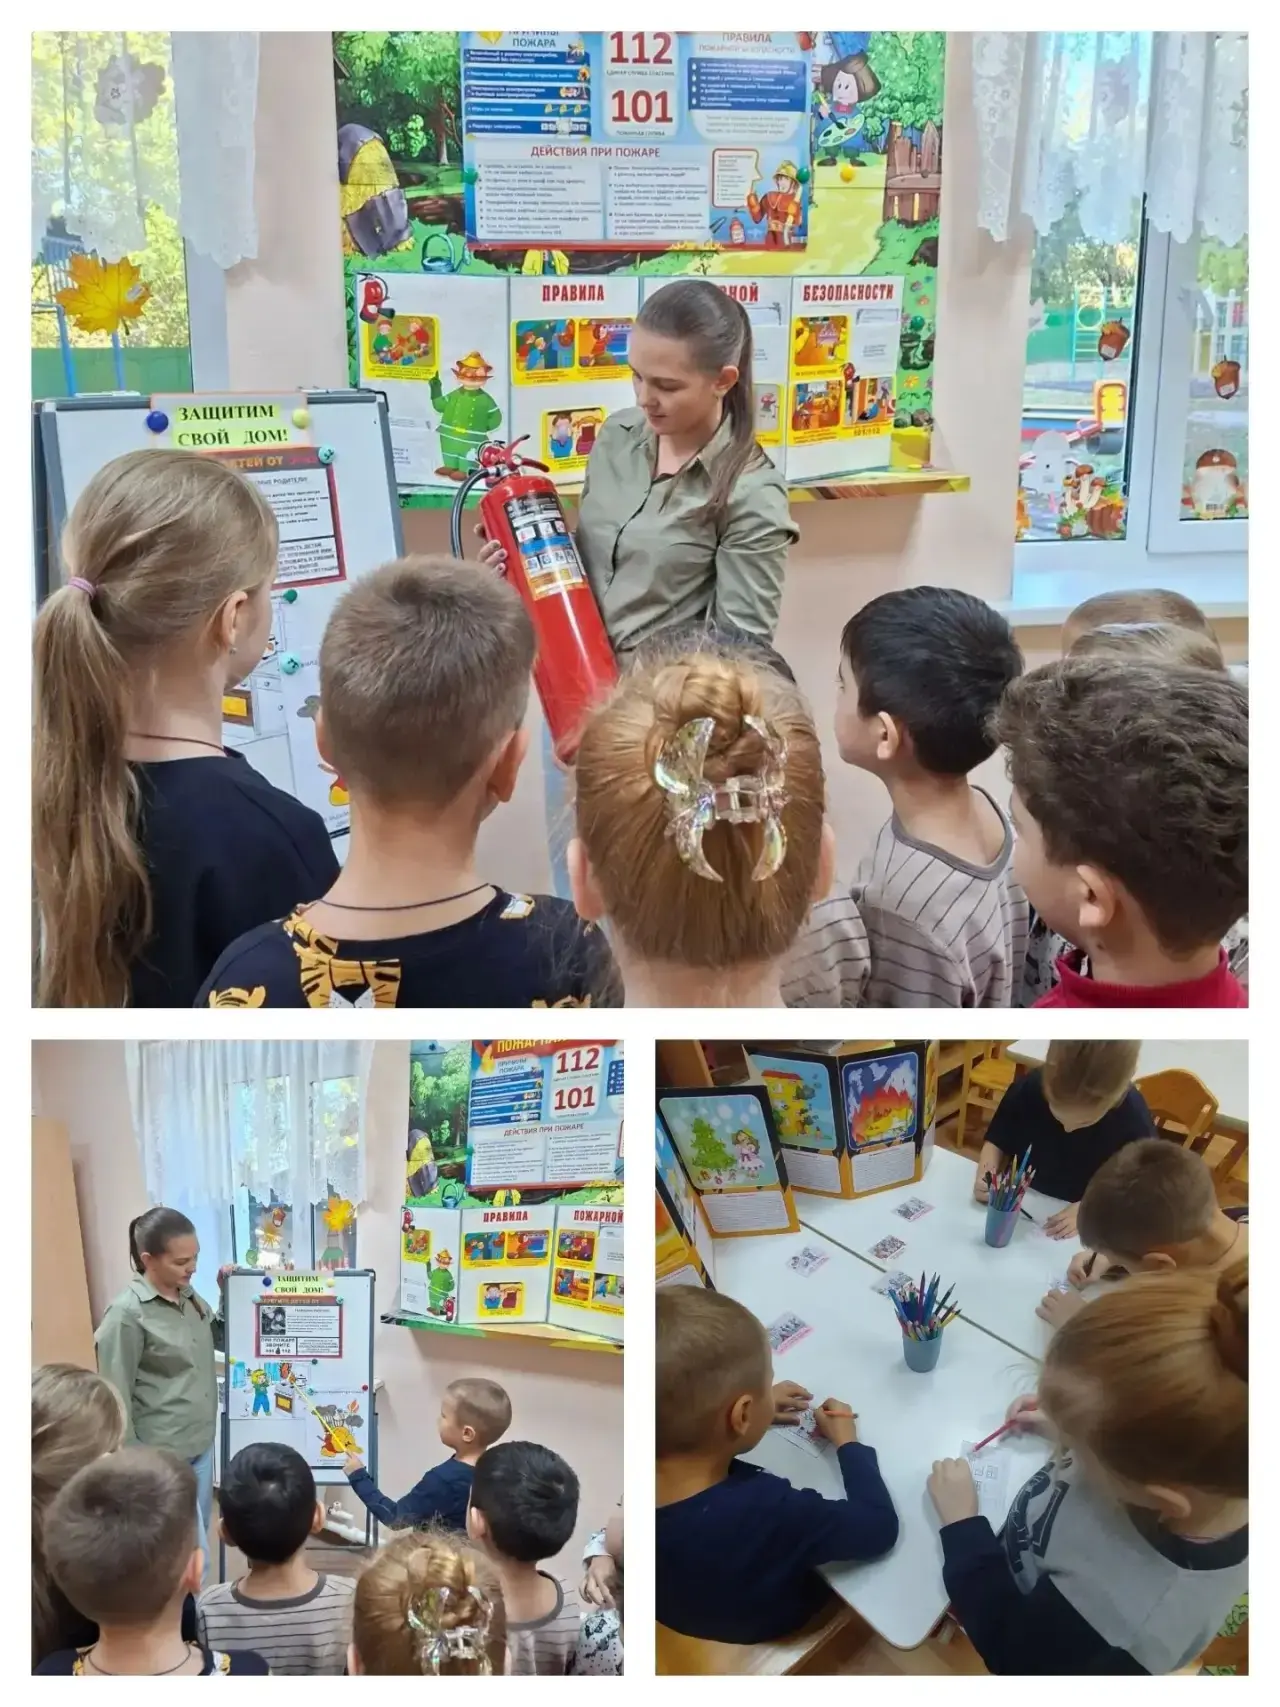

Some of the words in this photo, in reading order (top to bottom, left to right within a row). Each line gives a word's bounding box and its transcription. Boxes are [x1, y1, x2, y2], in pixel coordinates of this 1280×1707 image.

[512, 38, 557, 48] ПОЖАРА
[722, 32, 772, 43] ПРАВИЛА
[610, 31, 673, 64] 112
[611, 90, 673, 123] 101
[530, 144, 588, 158] ДЕЙСТВИЯ
[590, 147, 612, 157] ПРИ
[615, 147, 661, 158] ПОЖАРЕ
[542, 284, 605, 302] ПРАВИЛА
[718, 282, 759, 302] РНОЙ
[803, 284, 894, 302] БЕЗОПАСНОСТИ
[178, 404, 274, 422] ЗАЩИТИМ
[177, 428, 230, 446] СВОЙ
[243, 428, 288, 444] ДОМ!
[556, 1047, 600, 1074] 112
[554, 1086, 596, 1111] 101
[504, 1127, 538, 1137] ДЕЙСТВИЯ
[554, 1123, 585, 1131] ПОЖАРЕ
[483, 1211, 528, 1223] ПРАВИЛА
[573, 1209, 624, 1223] ПОЖАРНОЙ
